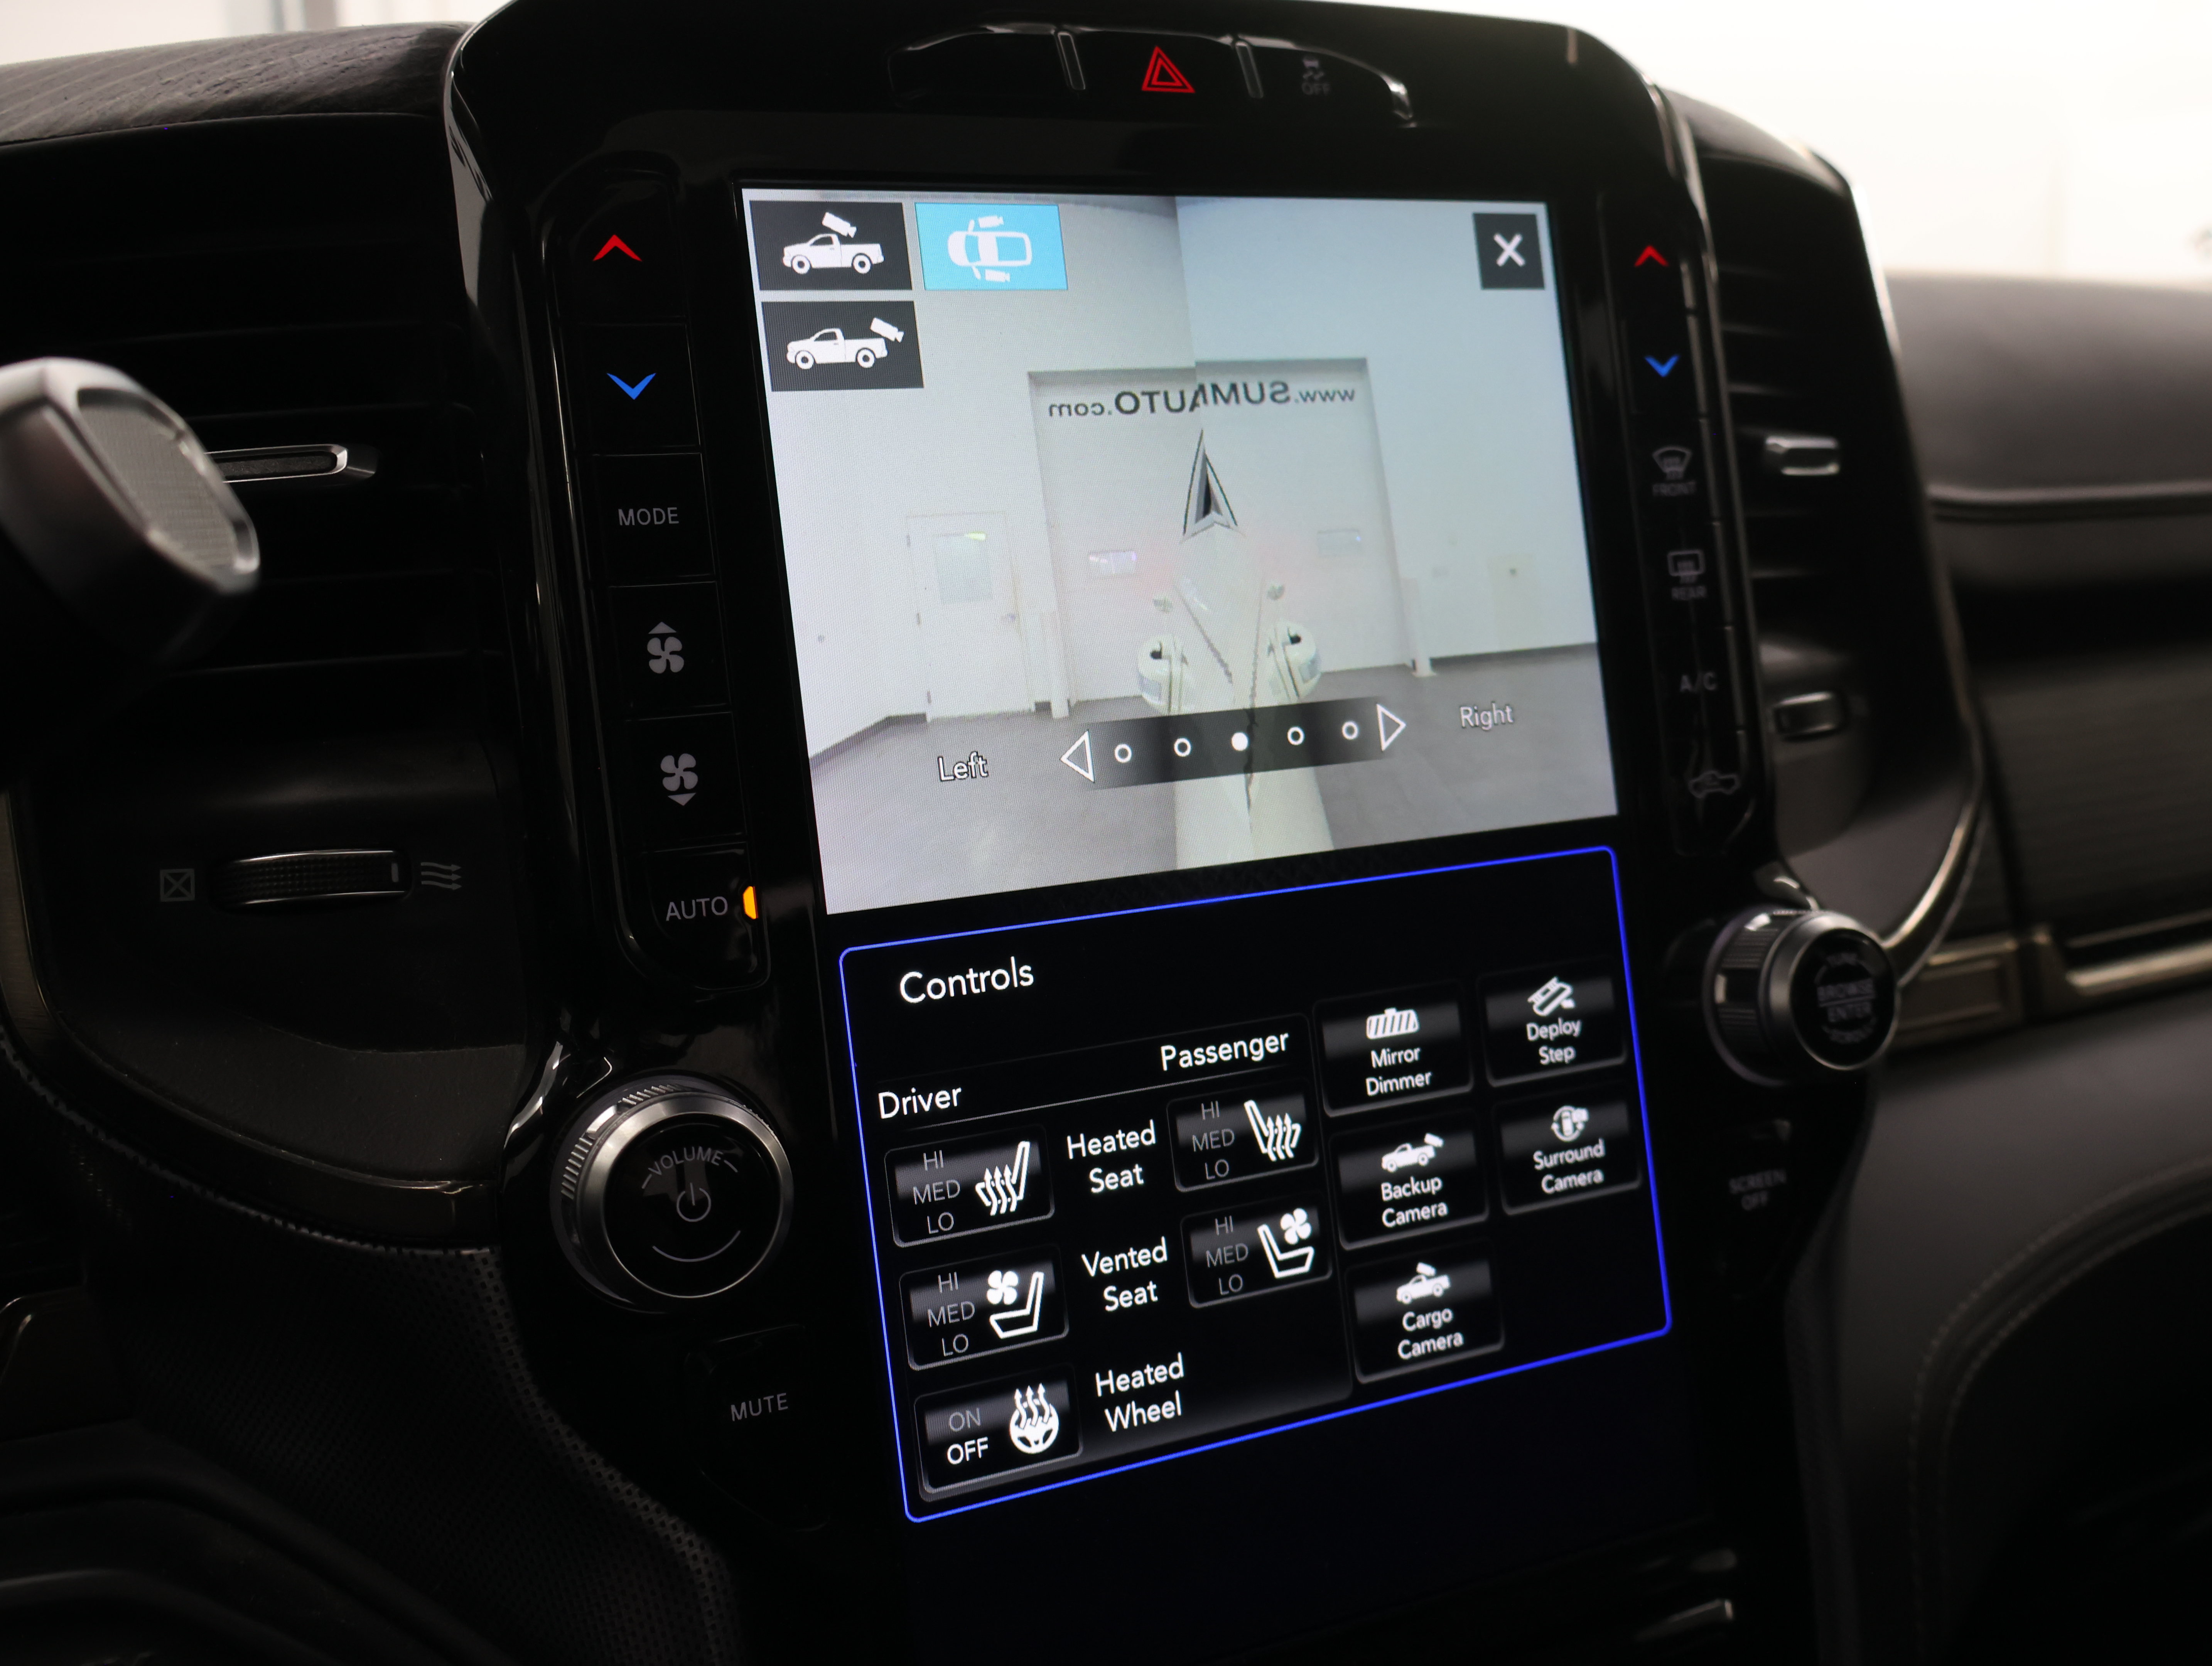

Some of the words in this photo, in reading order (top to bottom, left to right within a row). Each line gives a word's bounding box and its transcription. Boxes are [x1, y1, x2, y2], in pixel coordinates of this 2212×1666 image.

[618, 506, 679, 526] MODE
[1459, 703, 1514, 734] Right
[938, 750, 989, 781] Left
[665, 895, 729, 921] AUTO
[899, 956, 1034, 1004] Controls
[1526, 1017, 1581, 1041] Deploy
[1160, 1033, 1289, 1071] Passenger
[1370, 1047, 1421, 1068] Mirror
[1539, 1045, 1575, 1064] Step
[1365, 1072, 1432, 1096] Dimmer
[878, 1087, 962, 1120] Driver
[1201, 1101, 1220, 1121] HI
[1066, 1119, 1157, 1160] Heated
[1191, 1128, 1235, 1151] MED
[648, 1146, 724, 1177] VOLUME
[923, 1150, 945, 1172] HI
[1533, 1139, 1605, 1170] Surround
[1089, 1164, 1144, 1194] Seat
[1205, 1158, 1230, 1180] LO
[1541, 1168, 1604, 1194] Camera
[912, 1179, 960, 1204] MED
[1380, 1176, 1443, 1201] Backup
[926, 1211, 955, 1234] LO
[1215, 1216, 1234, 1236] HI
[1382, 1202, 1448, 1228] Camera
[1081, 1236, 1168, 1277] Vented
[1205, 1242, 1249, 1266] MED
[938, 1272, 959, 1294] HI
[1218, 1273, 1244, 1296] LO
[1103, 1281, 1159, 1312] Seat
[927, 1300, 975, 1327] MED
[1402, 1308, 1453, 1332] Cargo
[941, 1333, 969, 1357] LO
[1397, 1332, 1464, 1359] Camera
[1095, 1352, 1184, 1397] Heated
[730, 1392, 788, 1421] MUTE
[1104, 1390, 1182, 1432] Wheel
[948, 1408, 981, 1432] ON
[946, 1437, 989, 1465] OFF
